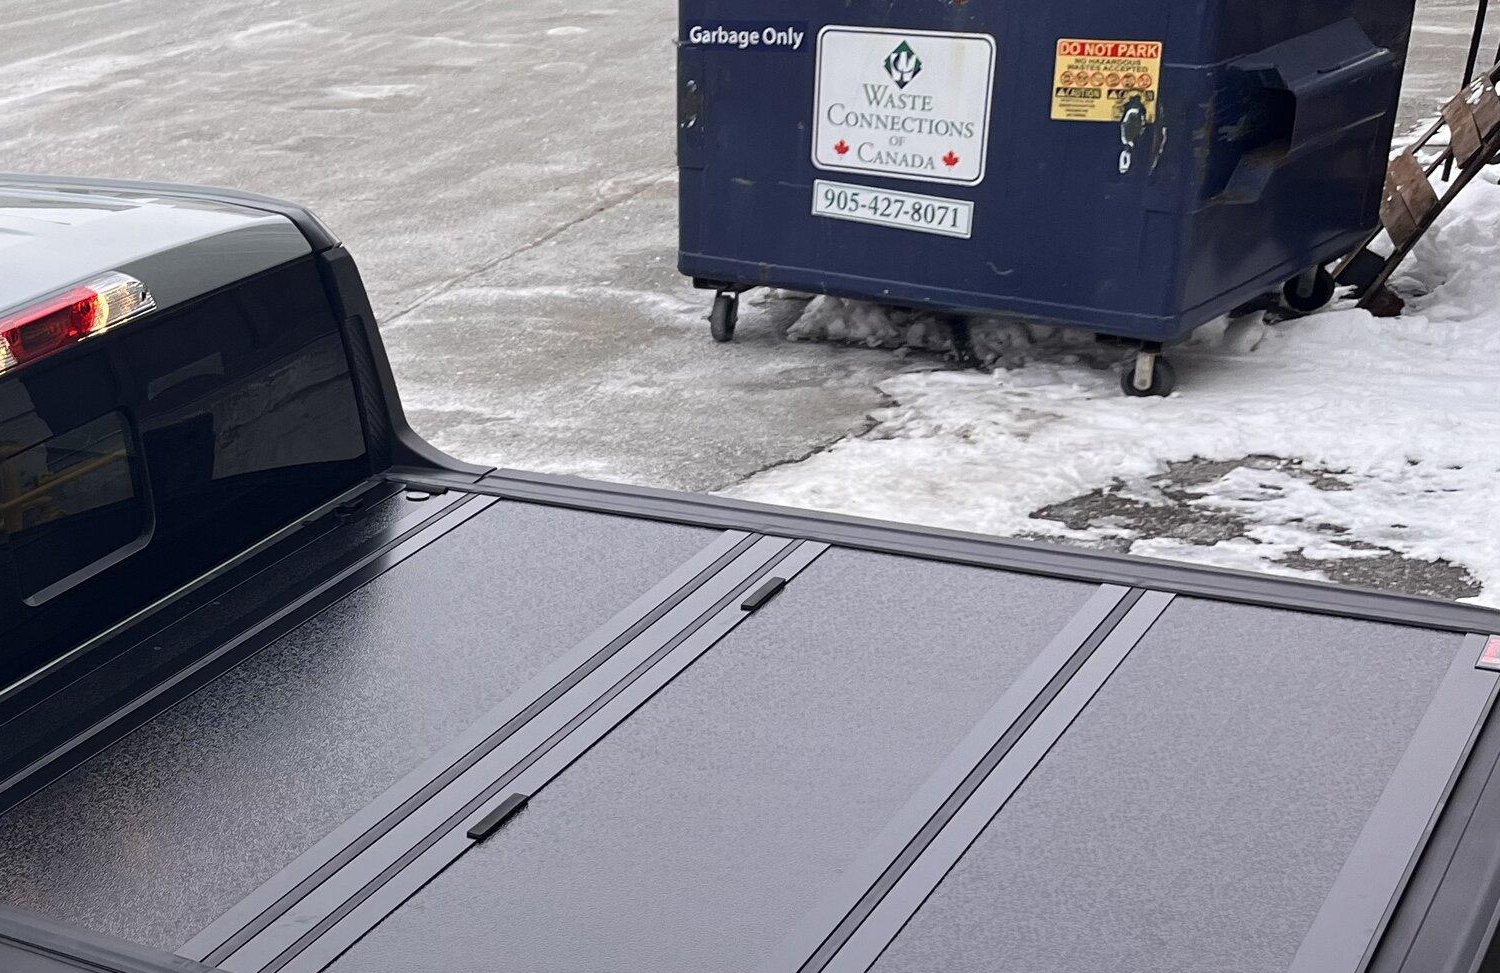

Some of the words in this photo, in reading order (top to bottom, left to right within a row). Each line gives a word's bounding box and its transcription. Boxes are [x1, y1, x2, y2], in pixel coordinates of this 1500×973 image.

[689, 25, 760, 49] Garbage
[762, 26, 804, 50] Only
[1060, 42, 1081, 55] DO
[1084, 43, 1113, 57] NOT
[1117, 44, 1157, 58] PARK
[863, 83, 933, 112] WASTE
[827, 102, 975, 139] CONNECTIONS
[857, 141, 936, 170] CANADA
[889, 135, 906, 147] OF
[824, 188, 961, 228] 905-427-8071
